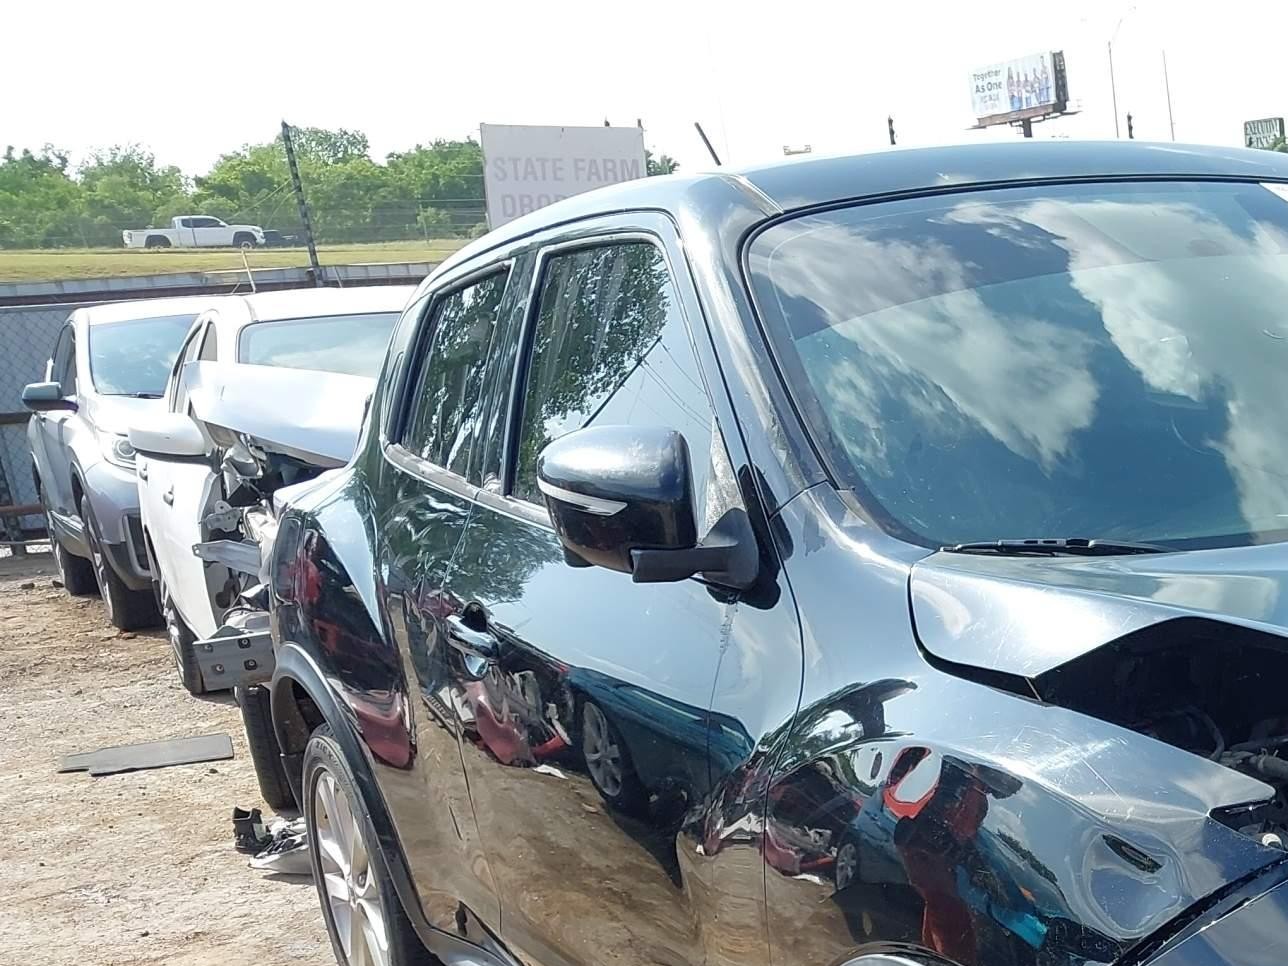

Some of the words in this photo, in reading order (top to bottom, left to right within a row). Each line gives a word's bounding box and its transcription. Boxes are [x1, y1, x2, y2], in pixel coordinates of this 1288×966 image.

[975, 84, 986, 93] As
[986, 82, 1002, 92] One
[493, 157, 564, 182] STATE
[573, 158, 641, 182] FARM
[502, 194, 568, 218] DRO
